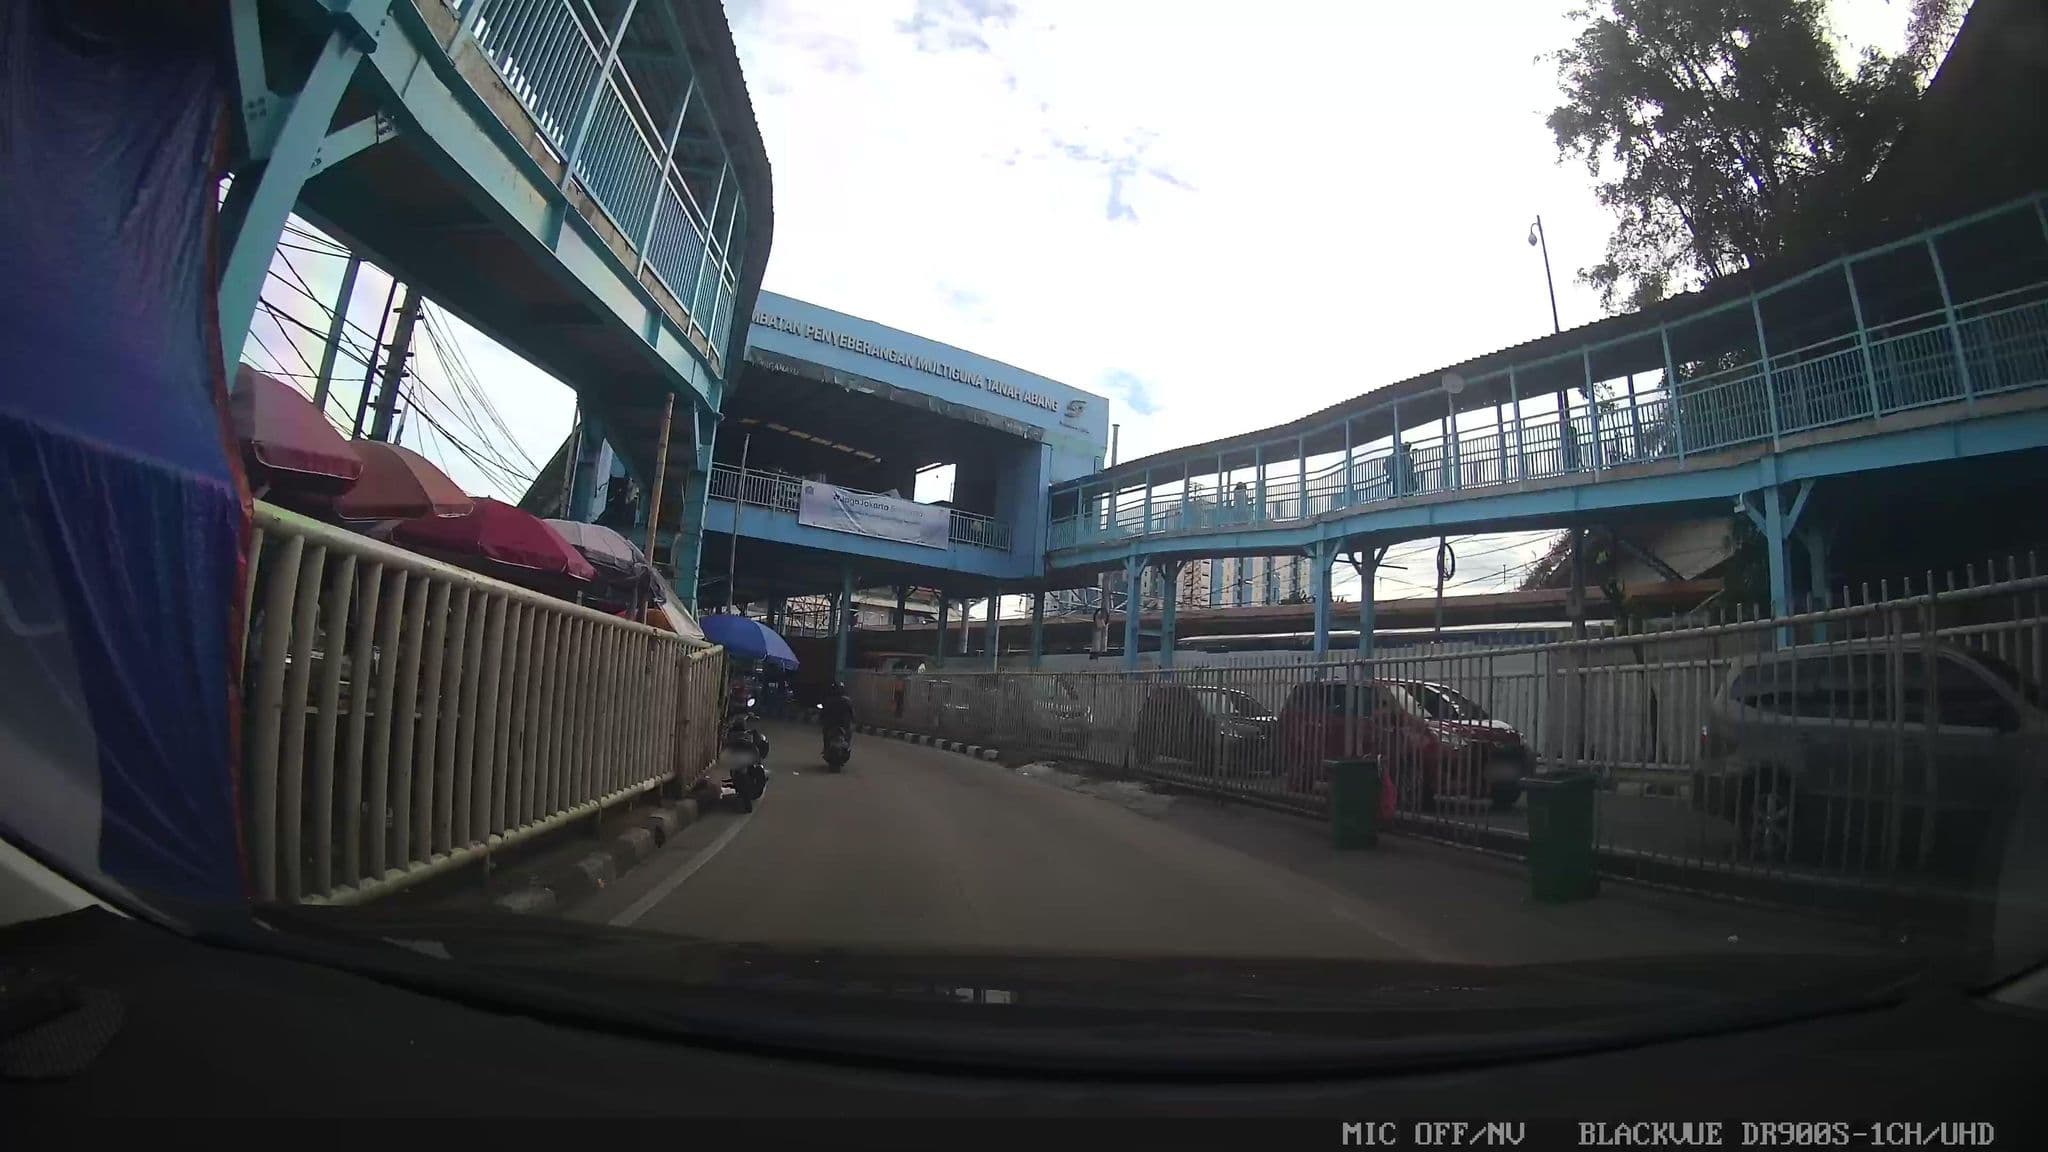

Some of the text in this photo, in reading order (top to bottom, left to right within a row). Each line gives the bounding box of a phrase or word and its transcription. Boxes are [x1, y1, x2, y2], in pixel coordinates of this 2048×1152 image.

[804, 323, 913, 369] PENYEBERANGAN
[916, 356, 983, 388] MULTIGUNA
[986, 377, 1022, 401] TANAH
[1023, 391, 1059, 412] ABANG
